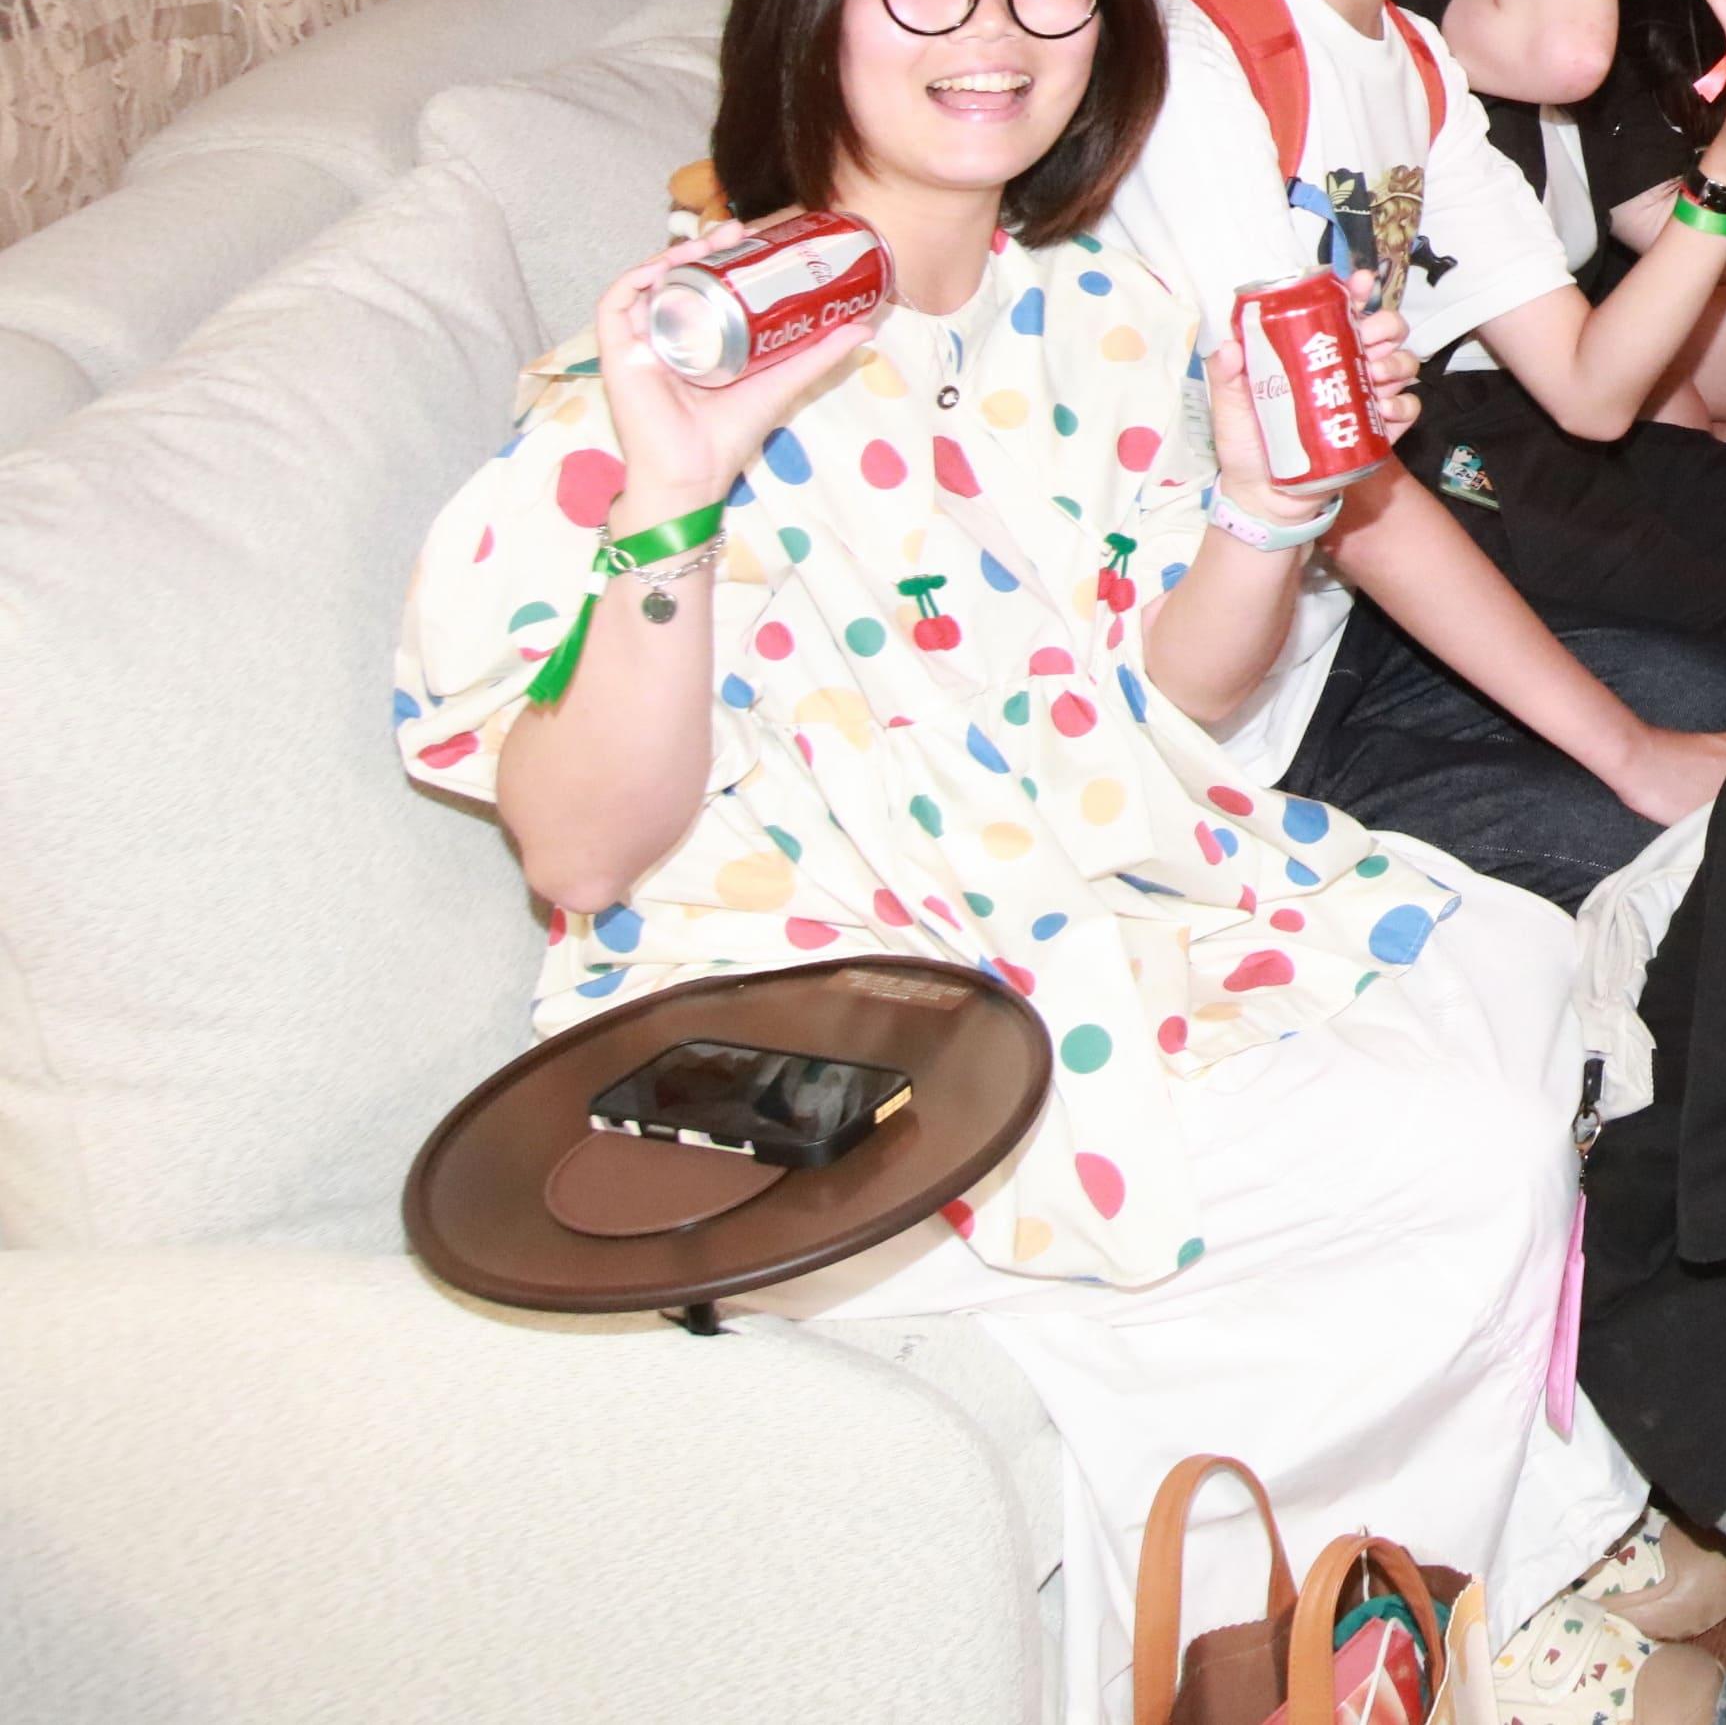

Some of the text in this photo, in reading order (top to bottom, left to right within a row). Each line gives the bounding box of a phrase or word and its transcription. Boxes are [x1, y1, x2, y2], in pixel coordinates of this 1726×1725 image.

[756, 289, 877, 357] Kalok Chow
[1302, 331, 1361, 450] 金城安
